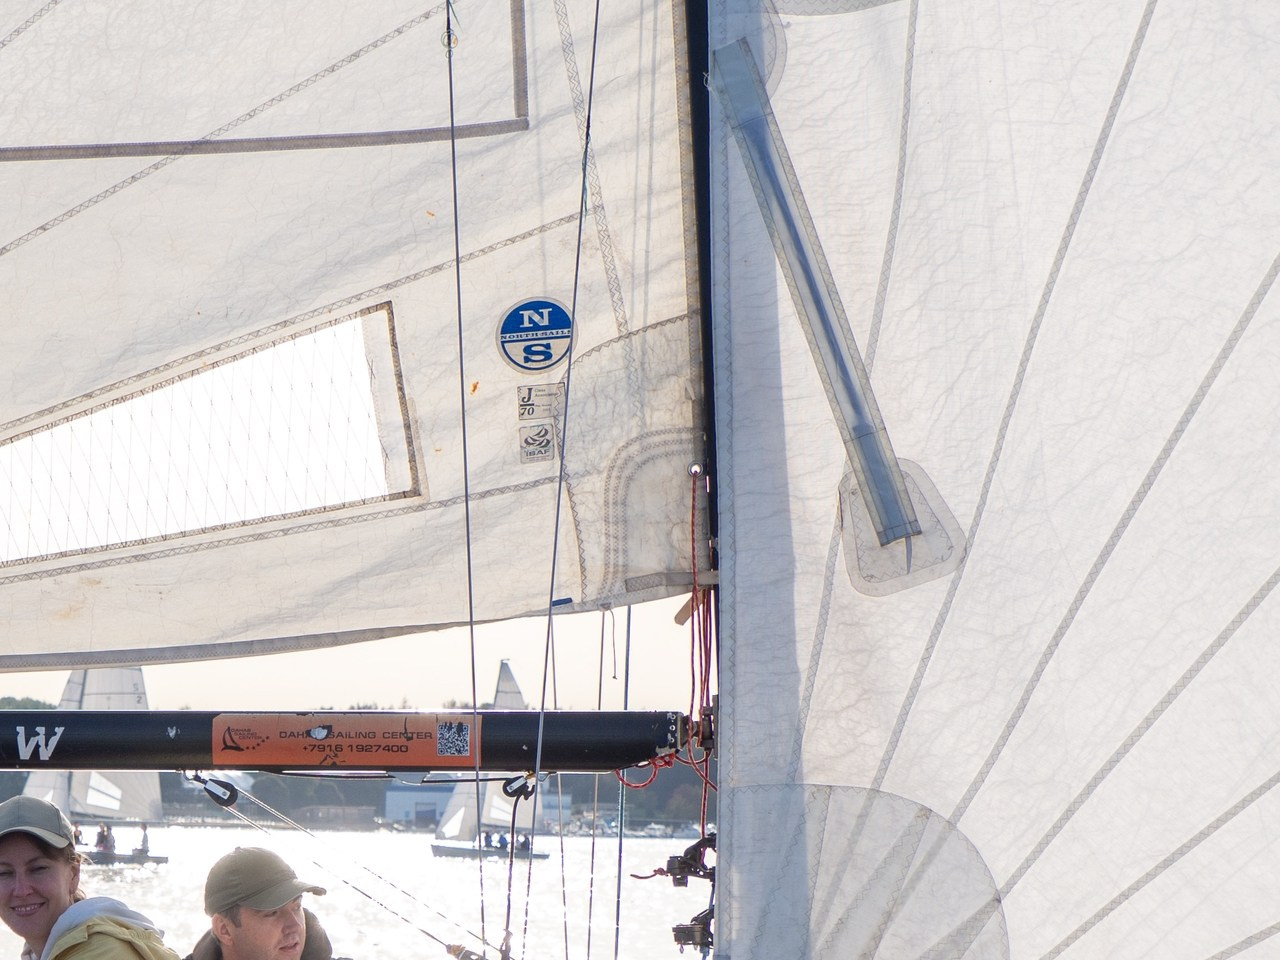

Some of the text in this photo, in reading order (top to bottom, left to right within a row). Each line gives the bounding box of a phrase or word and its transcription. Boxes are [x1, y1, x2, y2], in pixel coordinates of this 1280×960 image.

[519, 308, 553, 328] N
[501, 332, 538, 340] NORTH
[523, 342, 553, 364] S
[520, 406, 535, 416] 70
[279, 731, 321, 739] DAH
[382, 731, 433, 740] CENTER
[303, 744, 409, 753] +7916 1927400
